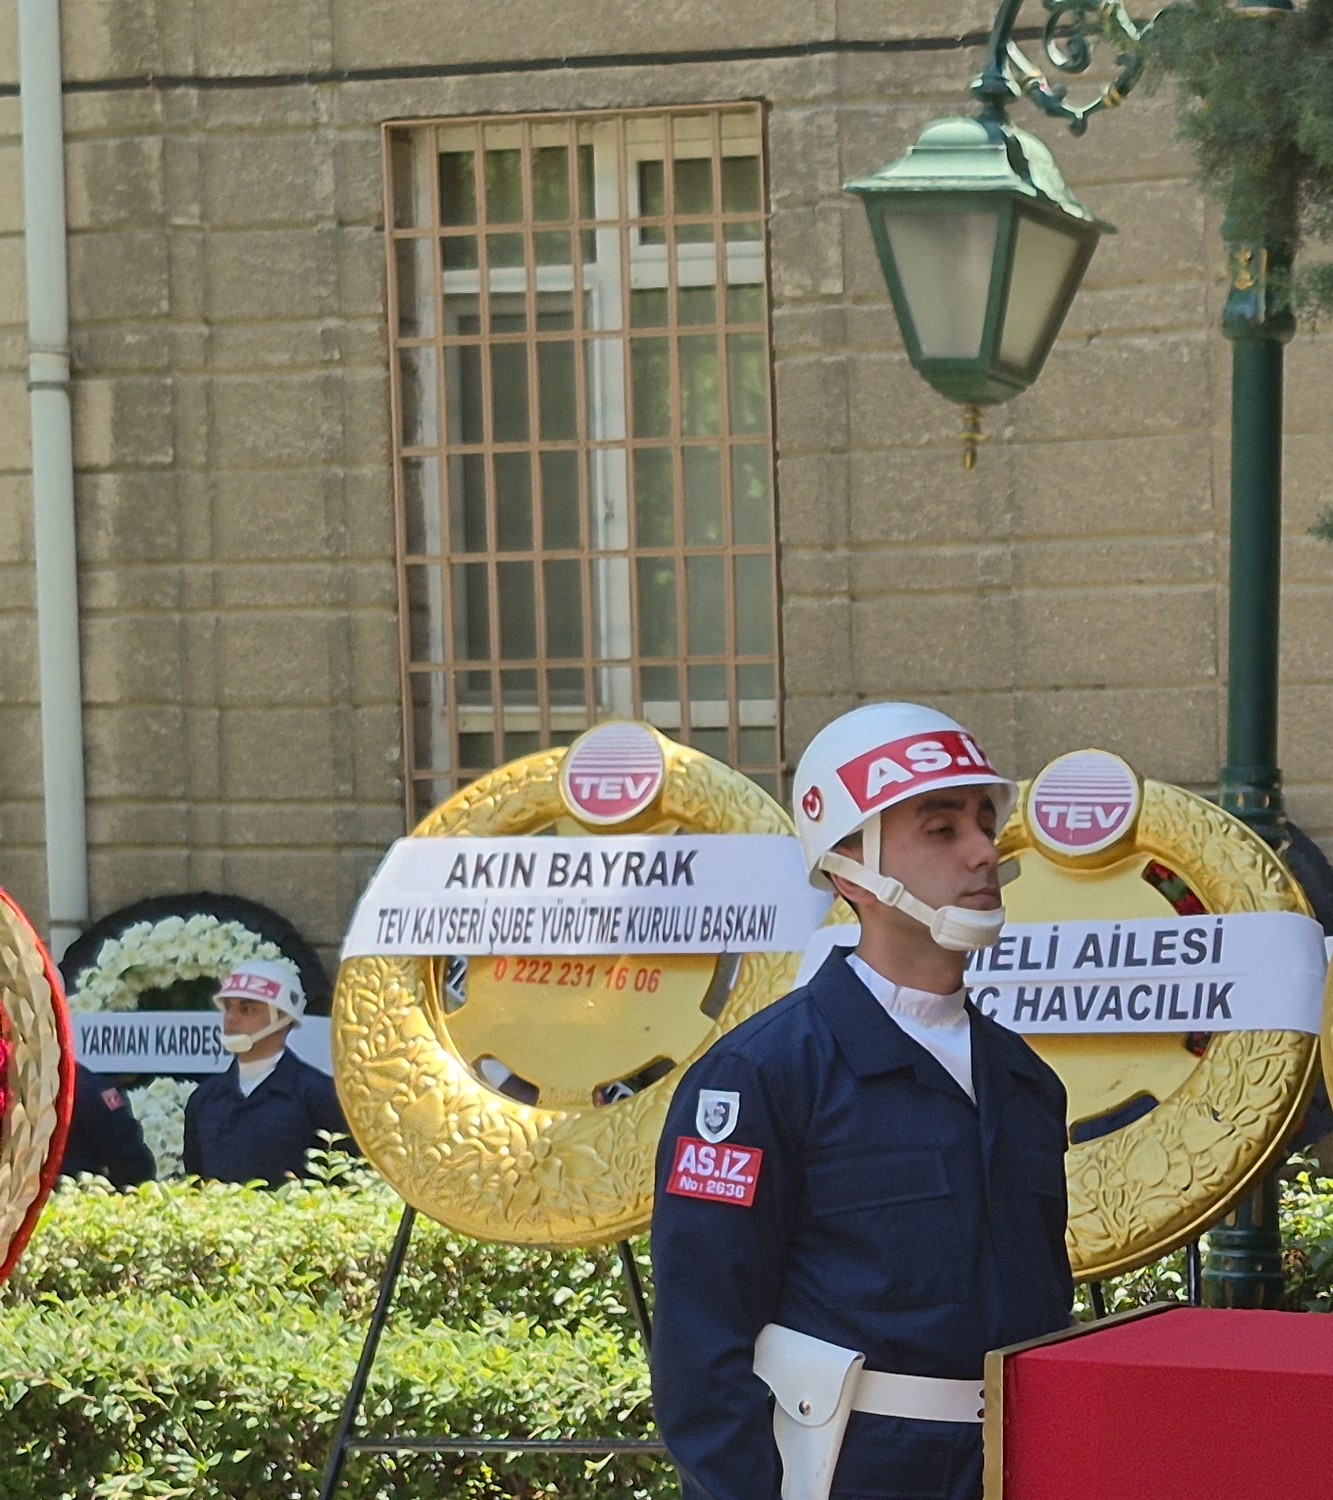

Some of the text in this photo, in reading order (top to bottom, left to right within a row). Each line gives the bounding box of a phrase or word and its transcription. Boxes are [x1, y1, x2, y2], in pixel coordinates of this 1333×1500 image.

[866, 732, 992, 800] AS.İ
[575, 776, 653, 800] TEV
[1041, 804, 1125, 829] TEV
[445, 849, 698, 889] AKIN BAYRAK
[377, 898, 777, 952] TEV KAYSERİ ŞUBE YÜRÜTME KURULU BAŞKANI
[1072, 917, 1223, 969] AİLESİ
[494, 956, 507, 982] 0
[513, 959, 553, 984] 222
[557, 962, 596, 987] 231
[605, 965, 629, 991] 16
[634, 968, 661, 993] 06
[1012, 981, 1235, 1022] HAVACILIK
[81, 1024, 232, 1065] YARMAN KARDEŞ
